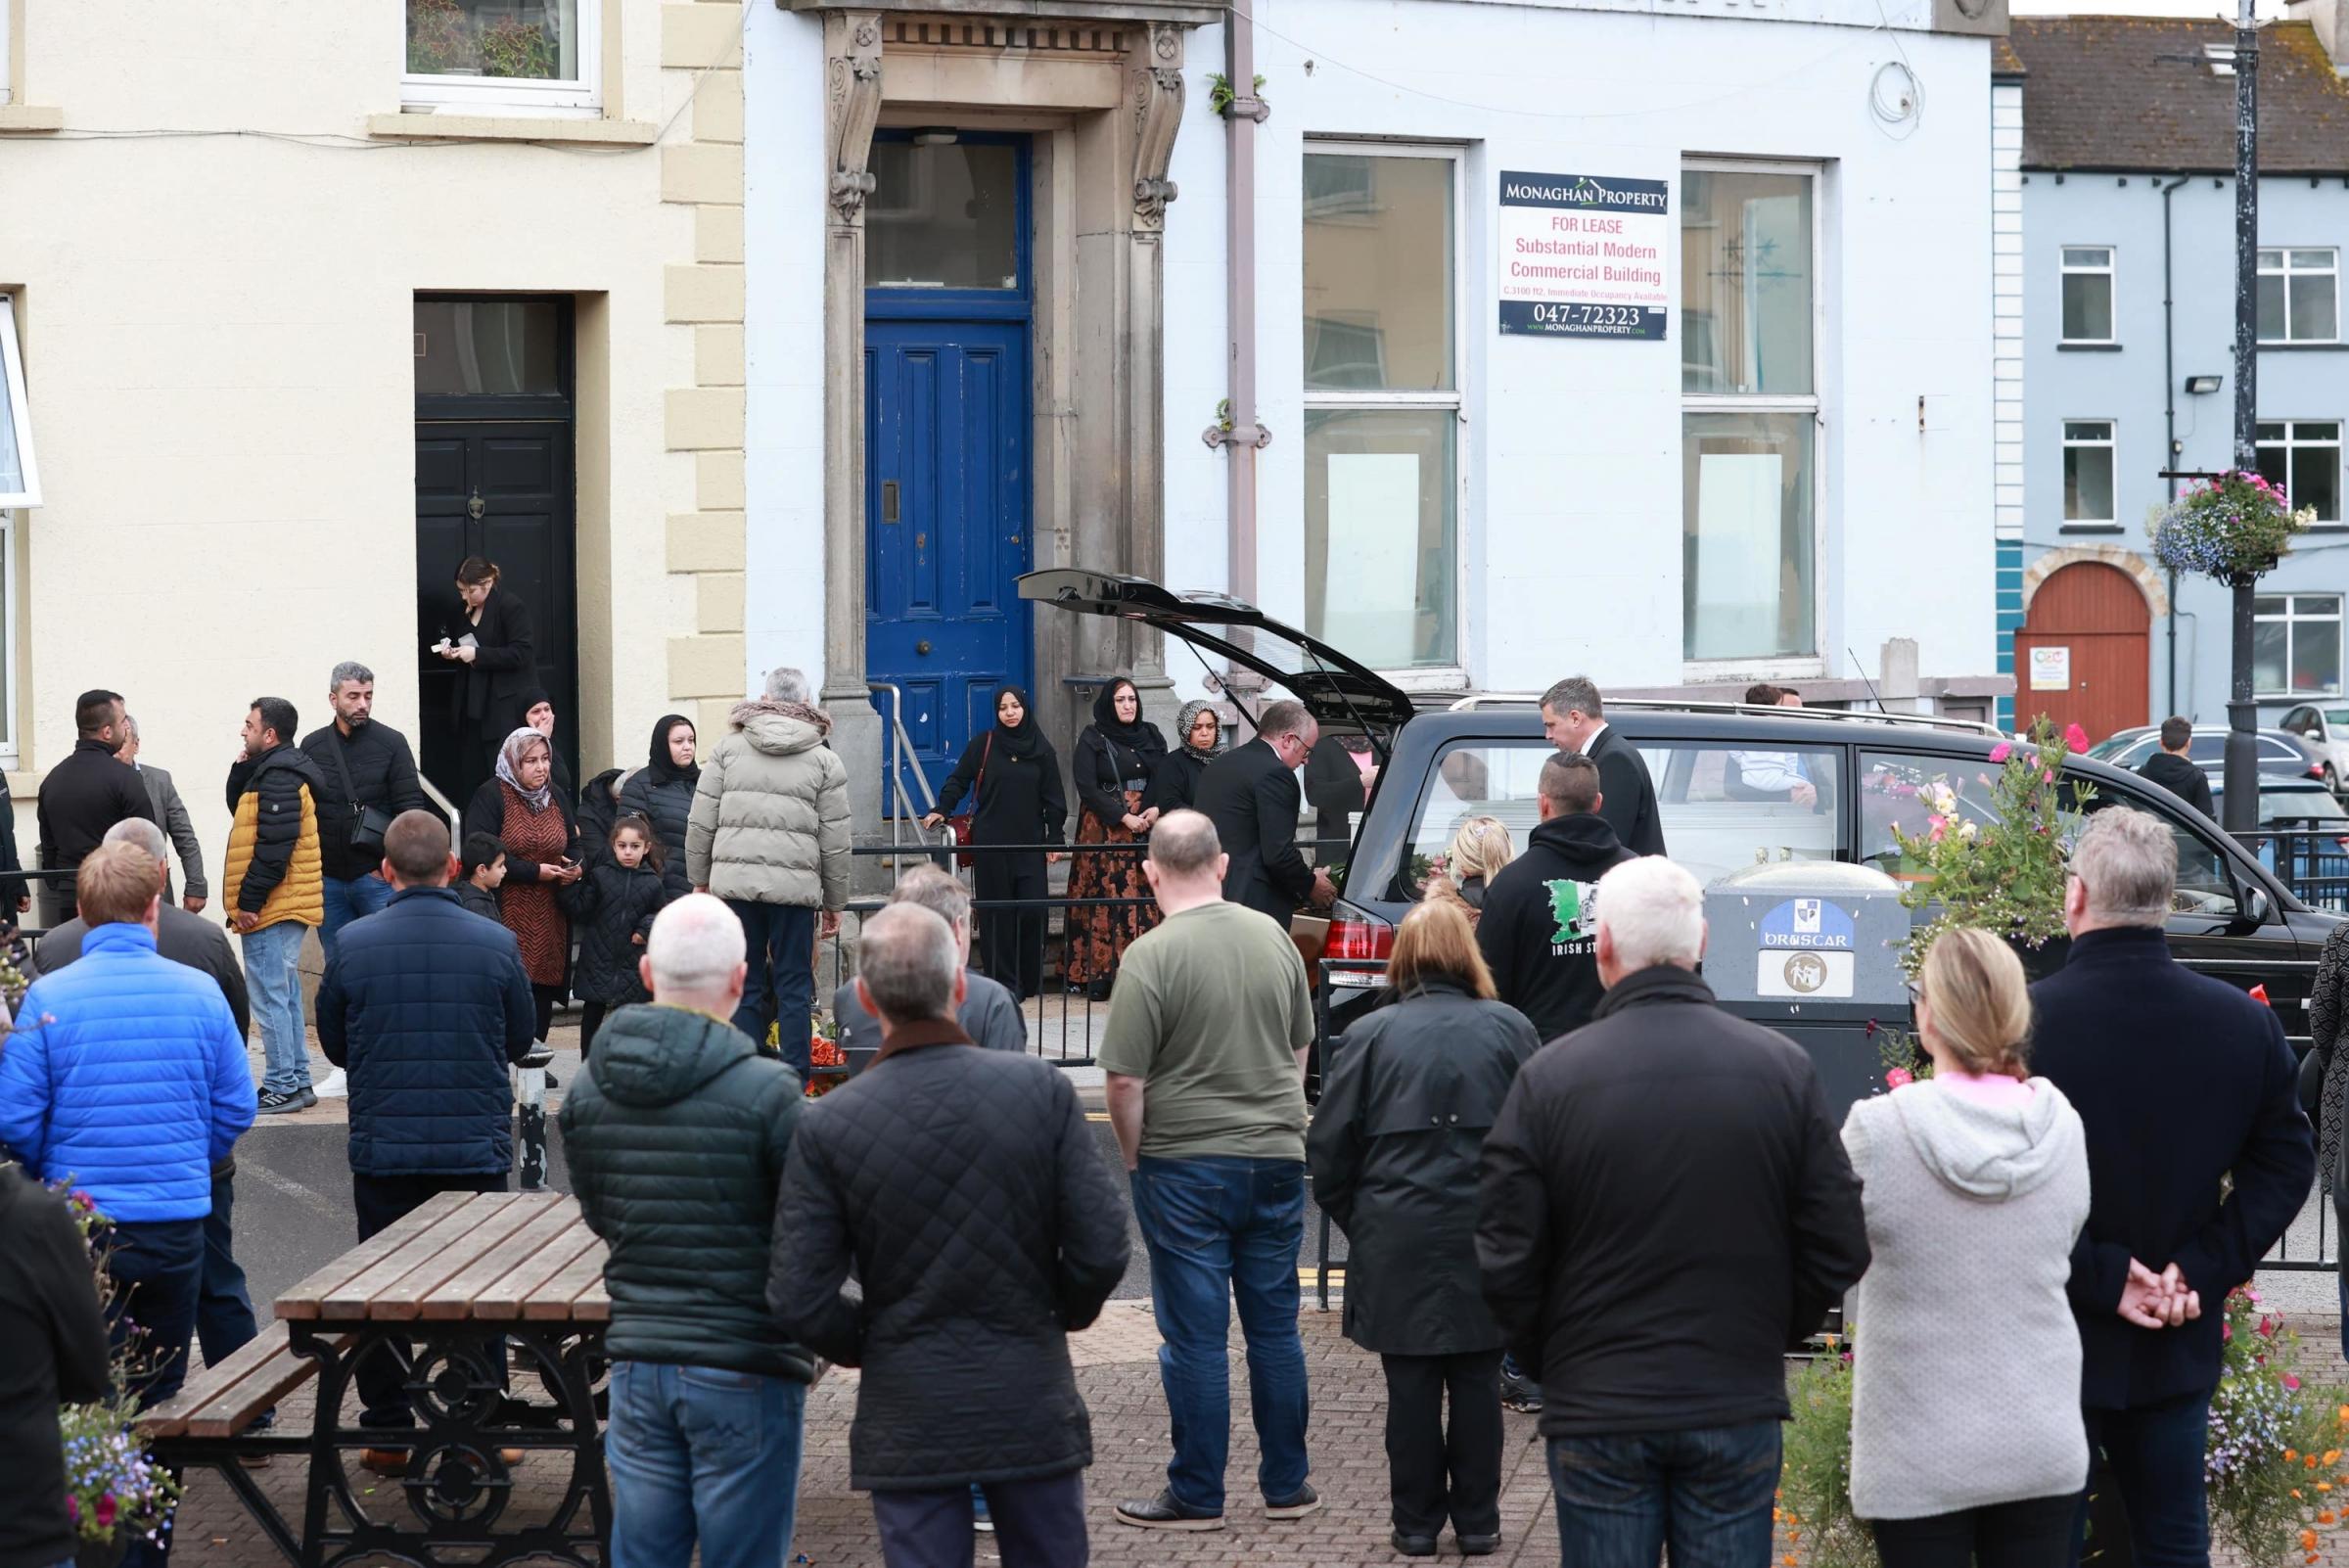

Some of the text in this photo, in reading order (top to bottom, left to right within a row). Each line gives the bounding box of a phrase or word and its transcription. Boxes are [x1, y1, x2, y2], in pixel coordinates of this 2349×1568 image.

[1505, 183, 1667, 208] MONAGHAN PROPERTY
[1552, 216, 1623, 234] FOR LEASE
[1515, 237, 1657, 259] Substantial Modern
[1510, 261, 1661, 287] Commercial Building
[1534, 303, 1640, 325] 047-72323
[1552, 943, 1583, 956] IRISH
